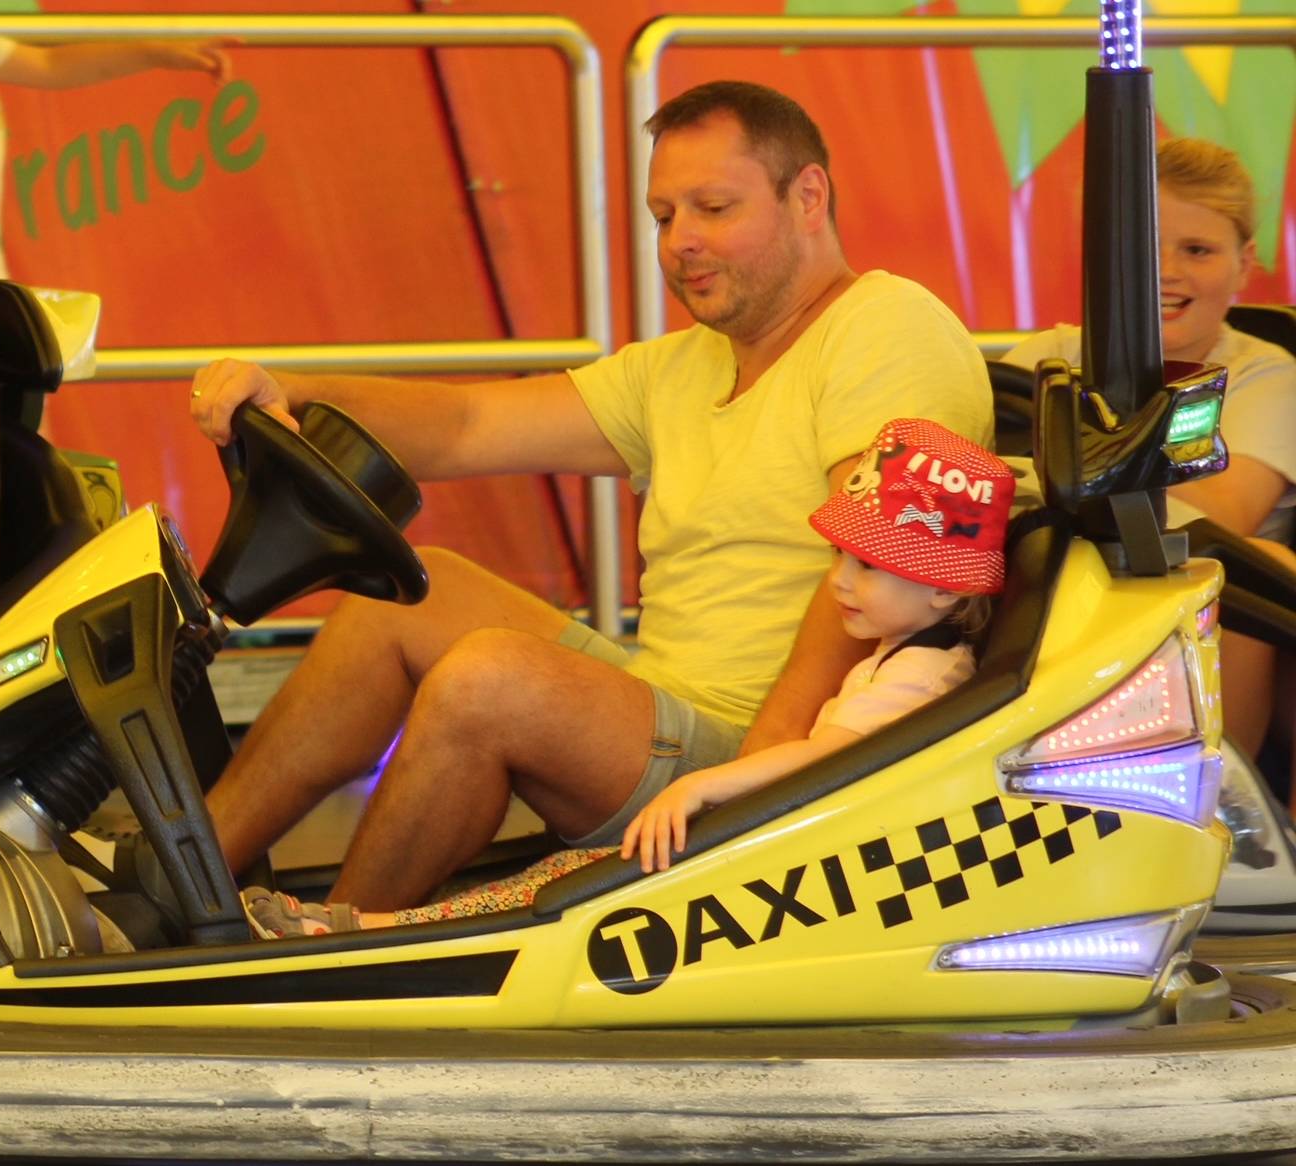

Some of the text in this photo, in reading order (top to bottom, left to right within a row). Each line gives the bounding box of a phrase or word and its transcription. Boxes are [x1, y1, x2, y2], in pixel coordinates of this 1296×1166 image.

[907, 452, 994, 505] I LOVE
[598, 854, 857, 982] TAXI
